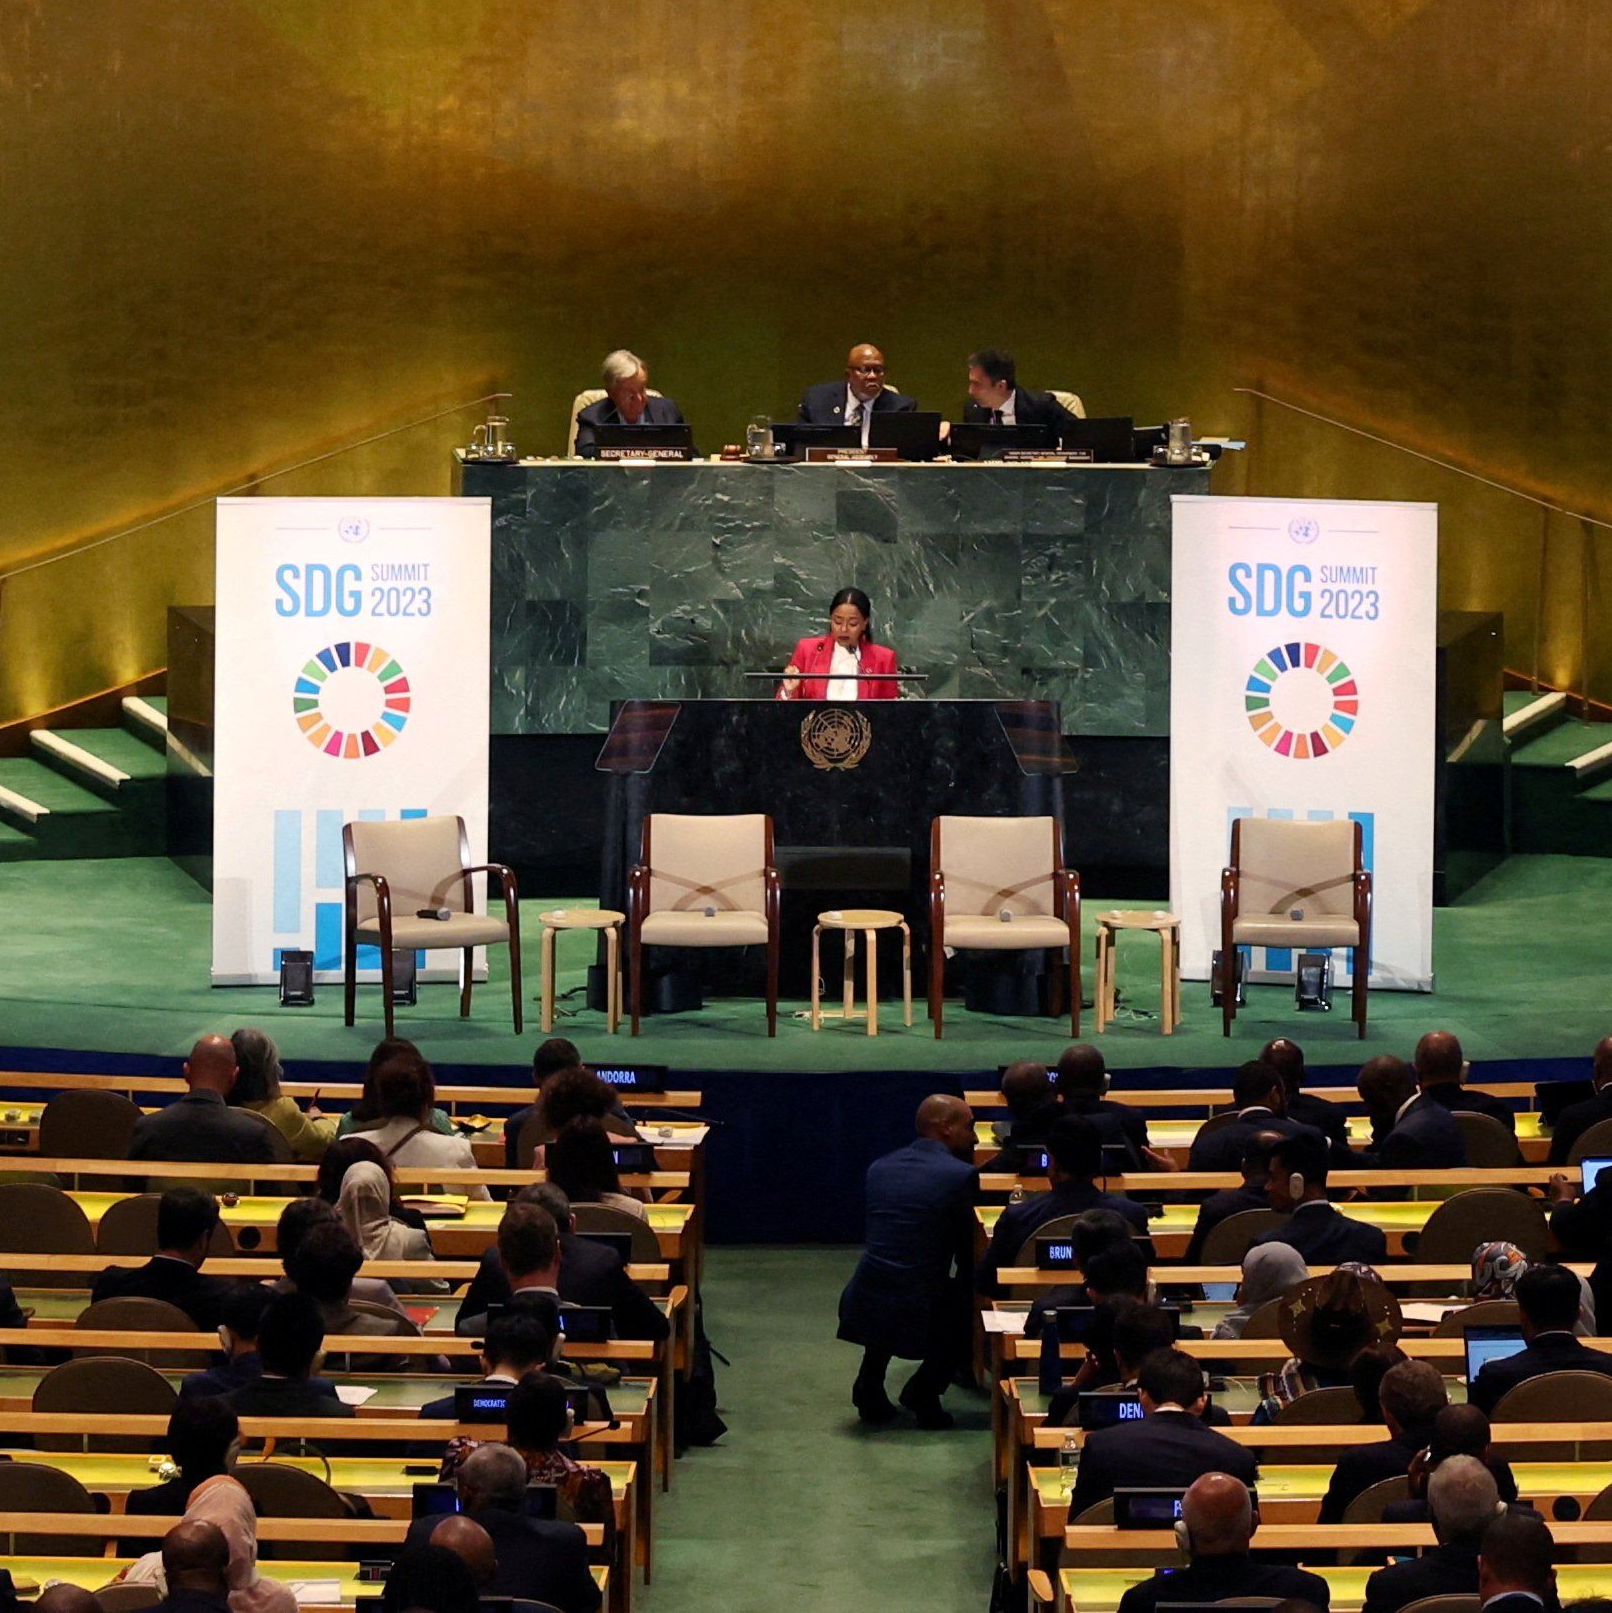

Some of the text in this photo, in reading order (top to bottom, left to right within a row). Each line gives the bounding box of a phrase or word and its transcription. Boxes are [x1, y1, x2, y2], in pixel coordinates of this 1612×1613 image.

[600, 449, 685, 459] SECRETARY-GENERAL
[371, 564, 430, 582] SUMMIT
[1320, 565, 1378, 585] SUMMIT
[275, 563, 363, 618] SDG
[1227, 562, 1313, 619] SDG
[371, 586, 432, 618] 2023
[1319, 589, 1380, 621] 2023
[1049, 1245, 1073, 1260] BRUN
[473, 1398, 507, 1408] DEMOCRATIC
[1119, 1402, 1145, 1419] DEN
